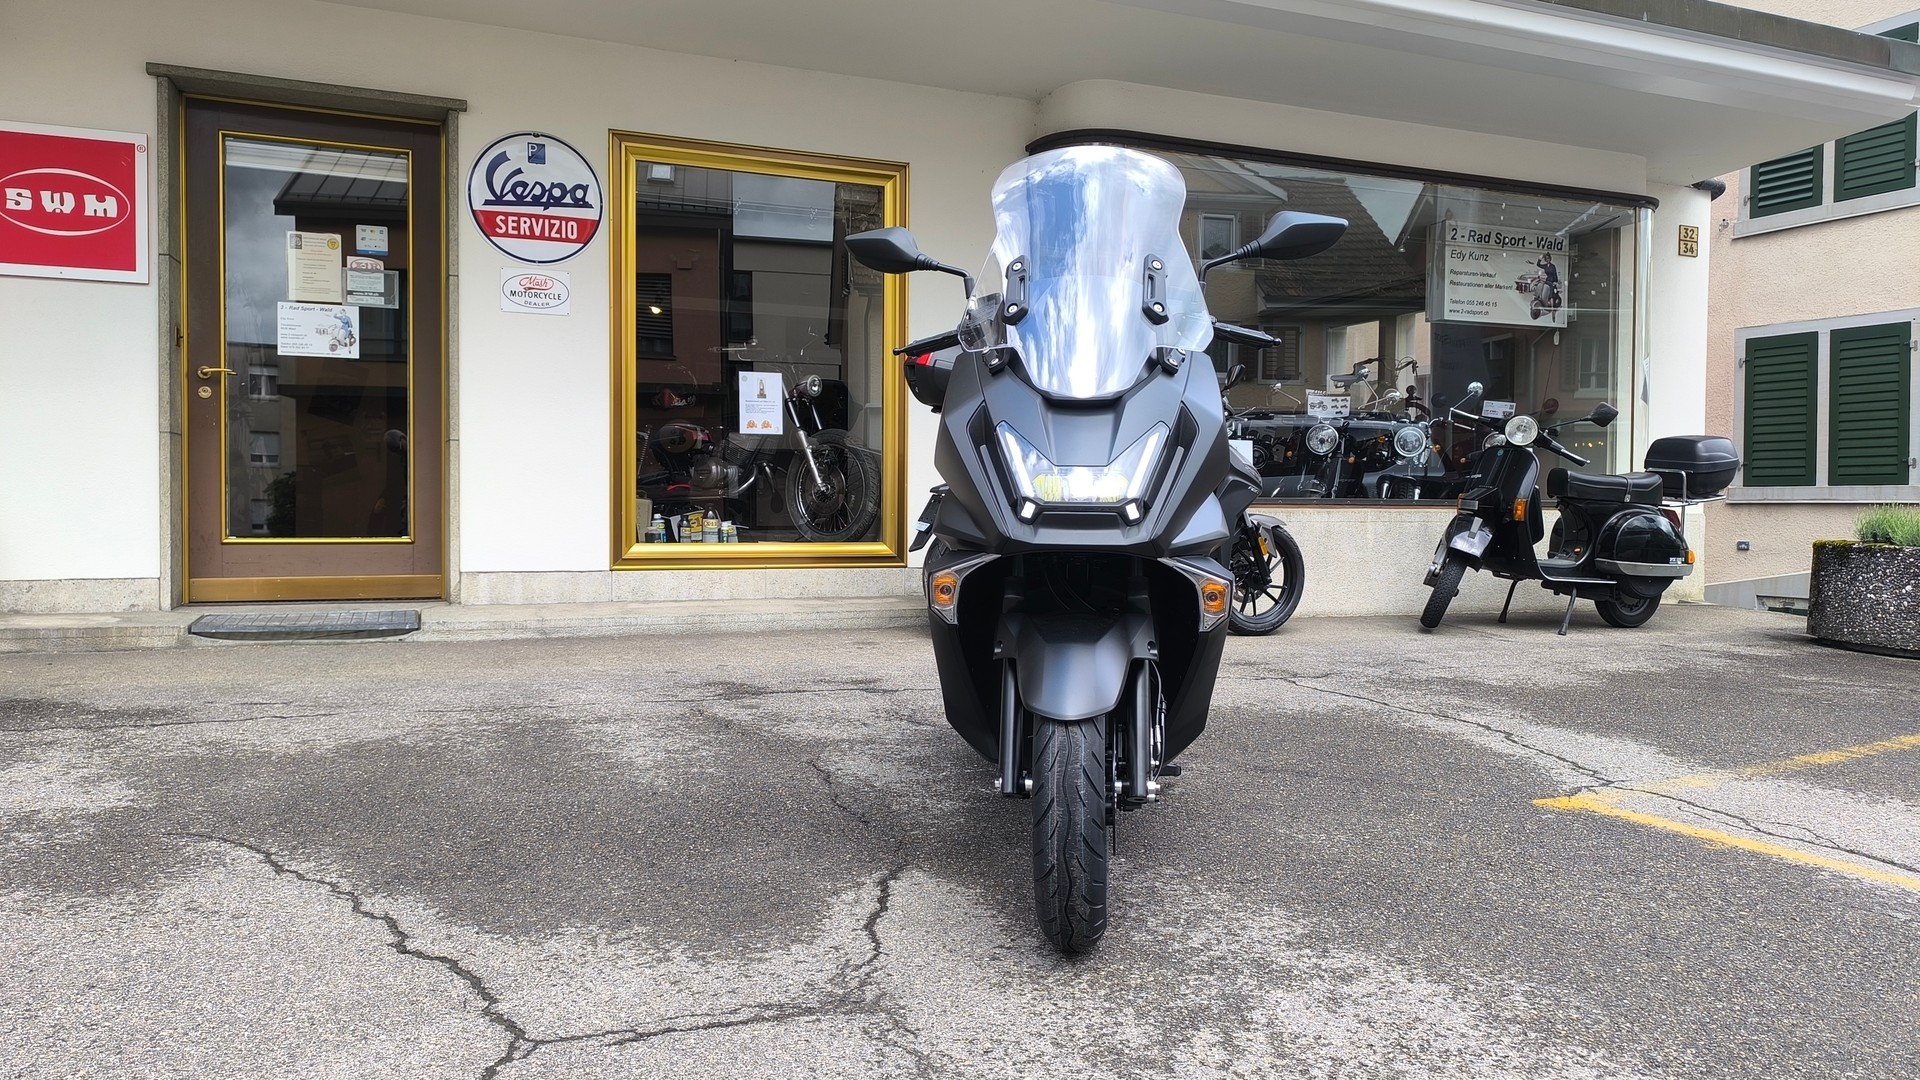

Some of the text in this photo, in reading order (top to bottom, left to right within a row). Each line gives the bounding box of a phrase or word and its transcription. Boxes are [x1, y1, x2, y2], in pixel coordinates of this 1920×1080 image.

[482, 150, 594, 211] Vespa
[495, 215, 578, 239] SERVIZIO
[1683, 227, 1695, 240] 32
[1450, 228, 1458, 240] 2
[1467, 229, 1491, 244] Rad
[1494, 232, 1526, 248] Sport
[1536, 236, 1564, 251] Wald
[1683, 242, 1695, 255] 34
[1450, 249, 1489, 262] Edy Kunz
[519, 276, 552, 289] Mash
[1449, 280, 1484, 288] Restaurationen
[510, 290, 562, 301] MOTORCYCLE
